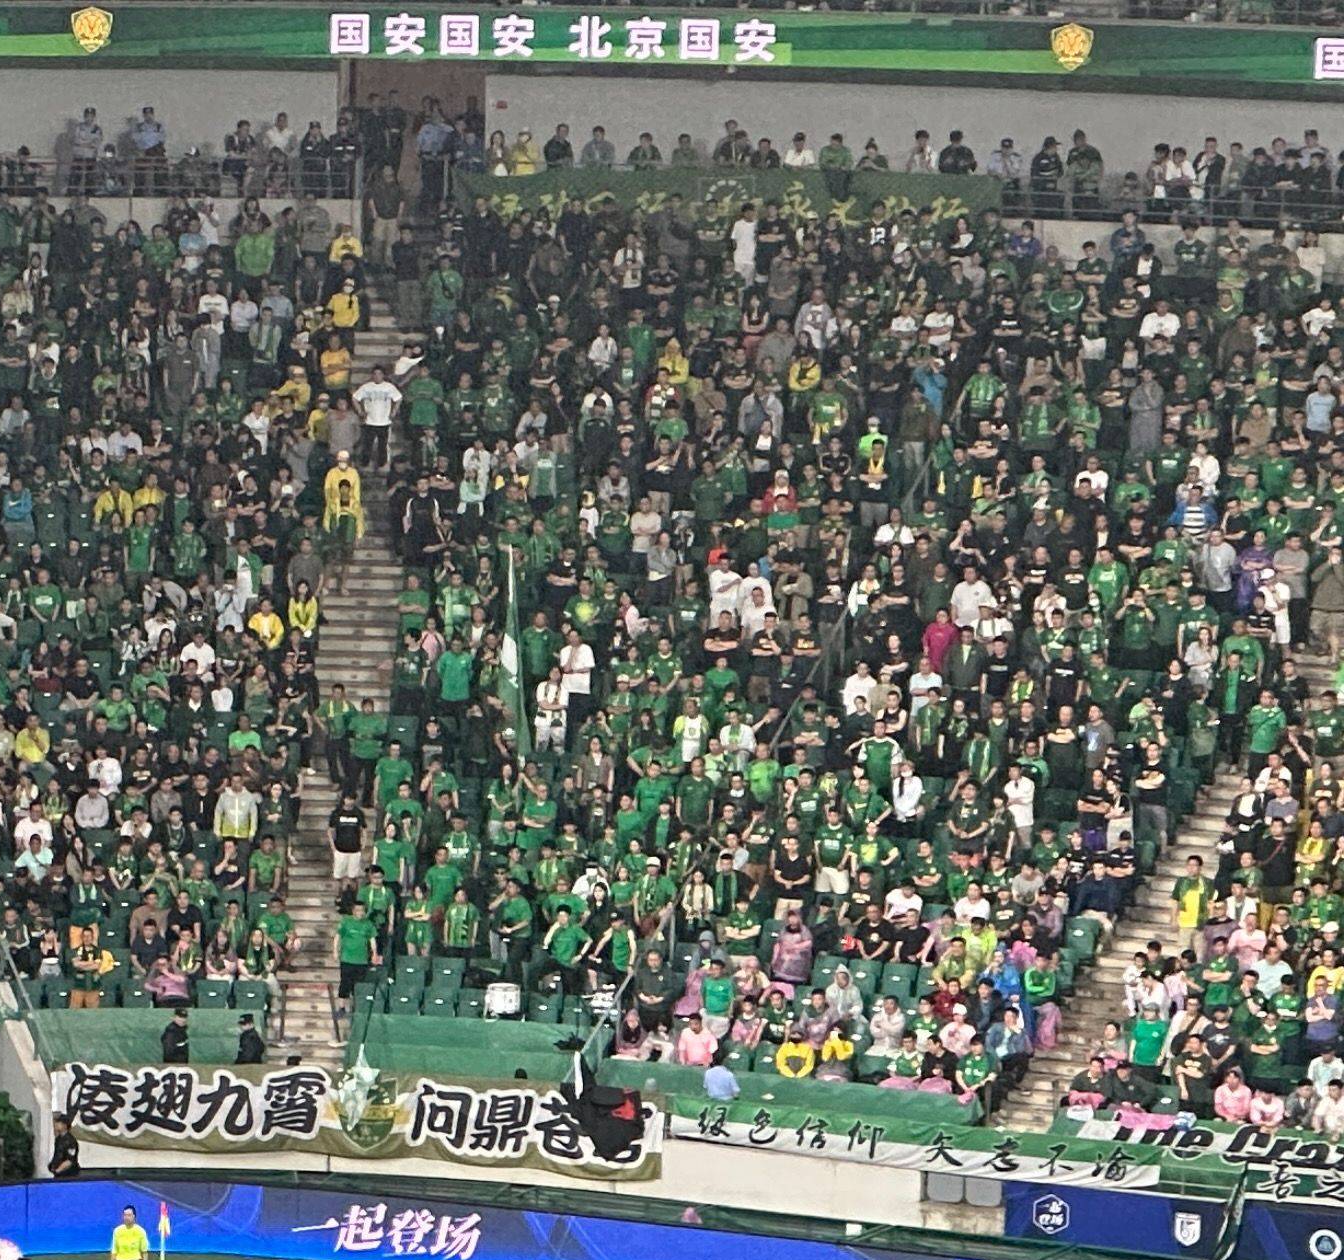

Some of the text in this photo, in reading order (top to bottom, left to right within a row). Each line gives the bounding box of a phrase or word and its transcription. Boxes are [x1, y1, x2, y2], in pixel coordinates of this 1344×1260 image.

[329, 13, 777, 62] 国安国安 北京国安
[410, 1086, 654, 1164] 问鼎苍
[696, 1106, 1138, 1182] 绿色信仰 矢志不渝
[1220, 1123, 1344, 1169] Cra
[291, 1203, 481, 1260] 一起登场
